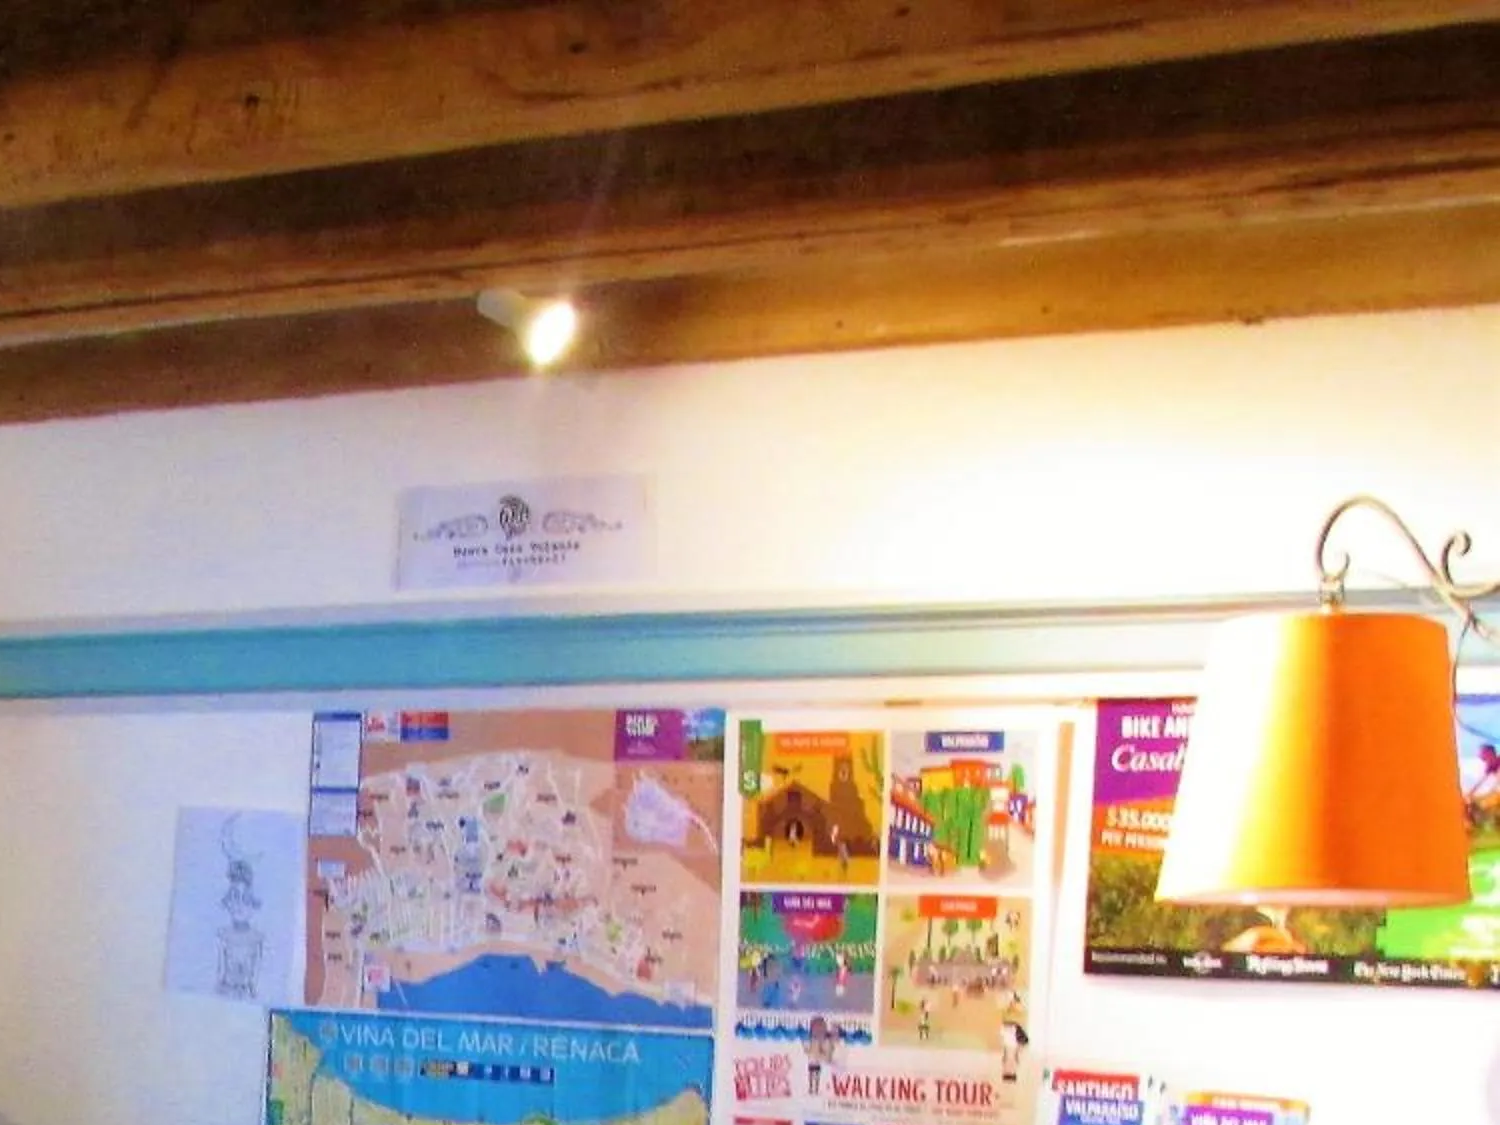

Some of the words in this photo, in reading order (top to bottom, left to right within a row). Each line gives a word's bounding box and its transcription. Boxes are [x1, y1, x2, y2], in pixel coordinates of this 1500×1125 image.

[1121, 715, 1161, 738] BIKE
[1163, 715, 1189, 738] AN
[402, 1026, 449, 1051] DEL
[458, 1030, 515, 1055] MAR
[830, 1073, 927, 1103] WALKING
[934, 1079, 994, 1105] TOUR
[1057, 1080, 1134, 1101] SANTIAGO
